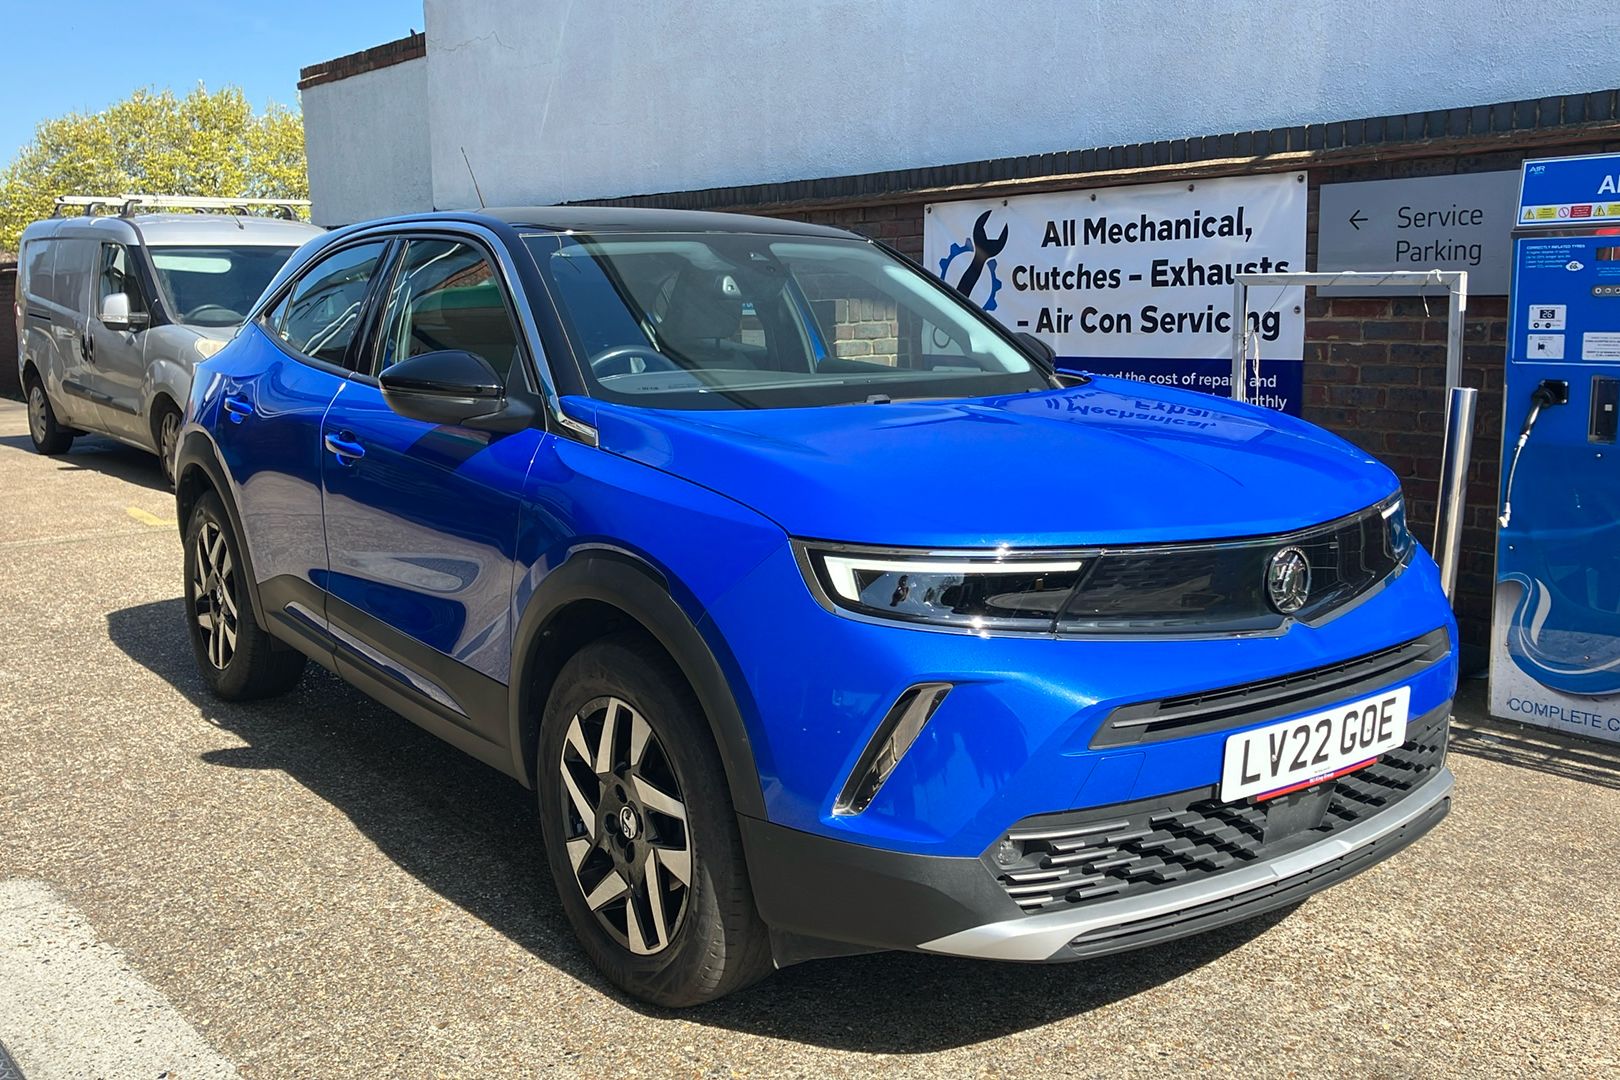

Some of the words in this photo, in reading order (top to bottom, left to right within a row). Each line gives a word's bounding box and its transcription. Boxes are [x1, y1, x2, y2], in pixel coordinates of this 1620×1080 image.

[1041, 219, 1076, 248] All
[1084, 206, 1253, 246] Mechanical,
[1397, 204, 1483, 229] Service
[1395, 238, 1482, 266] Parking
[1011, 262, 1121, 292] Clutches
[1035, 306, 1073, 333] Air
[1079, 306, 1132, 335] Con
[1140, 304, 1281, 341] Servicng
[1125, 371, 1146, 383] the
[1149, 373, 1178, 385] cost
[1181, 372, 1197, 385] of
[1198, 373, 1233, 389] repai
[1249, 374, 1277, 388] and
[1508, 696, 1602, 729] COMPLETE
[1239, 717, 1333, 787] LV22
[1339, 695, 1397, 756] GOE
